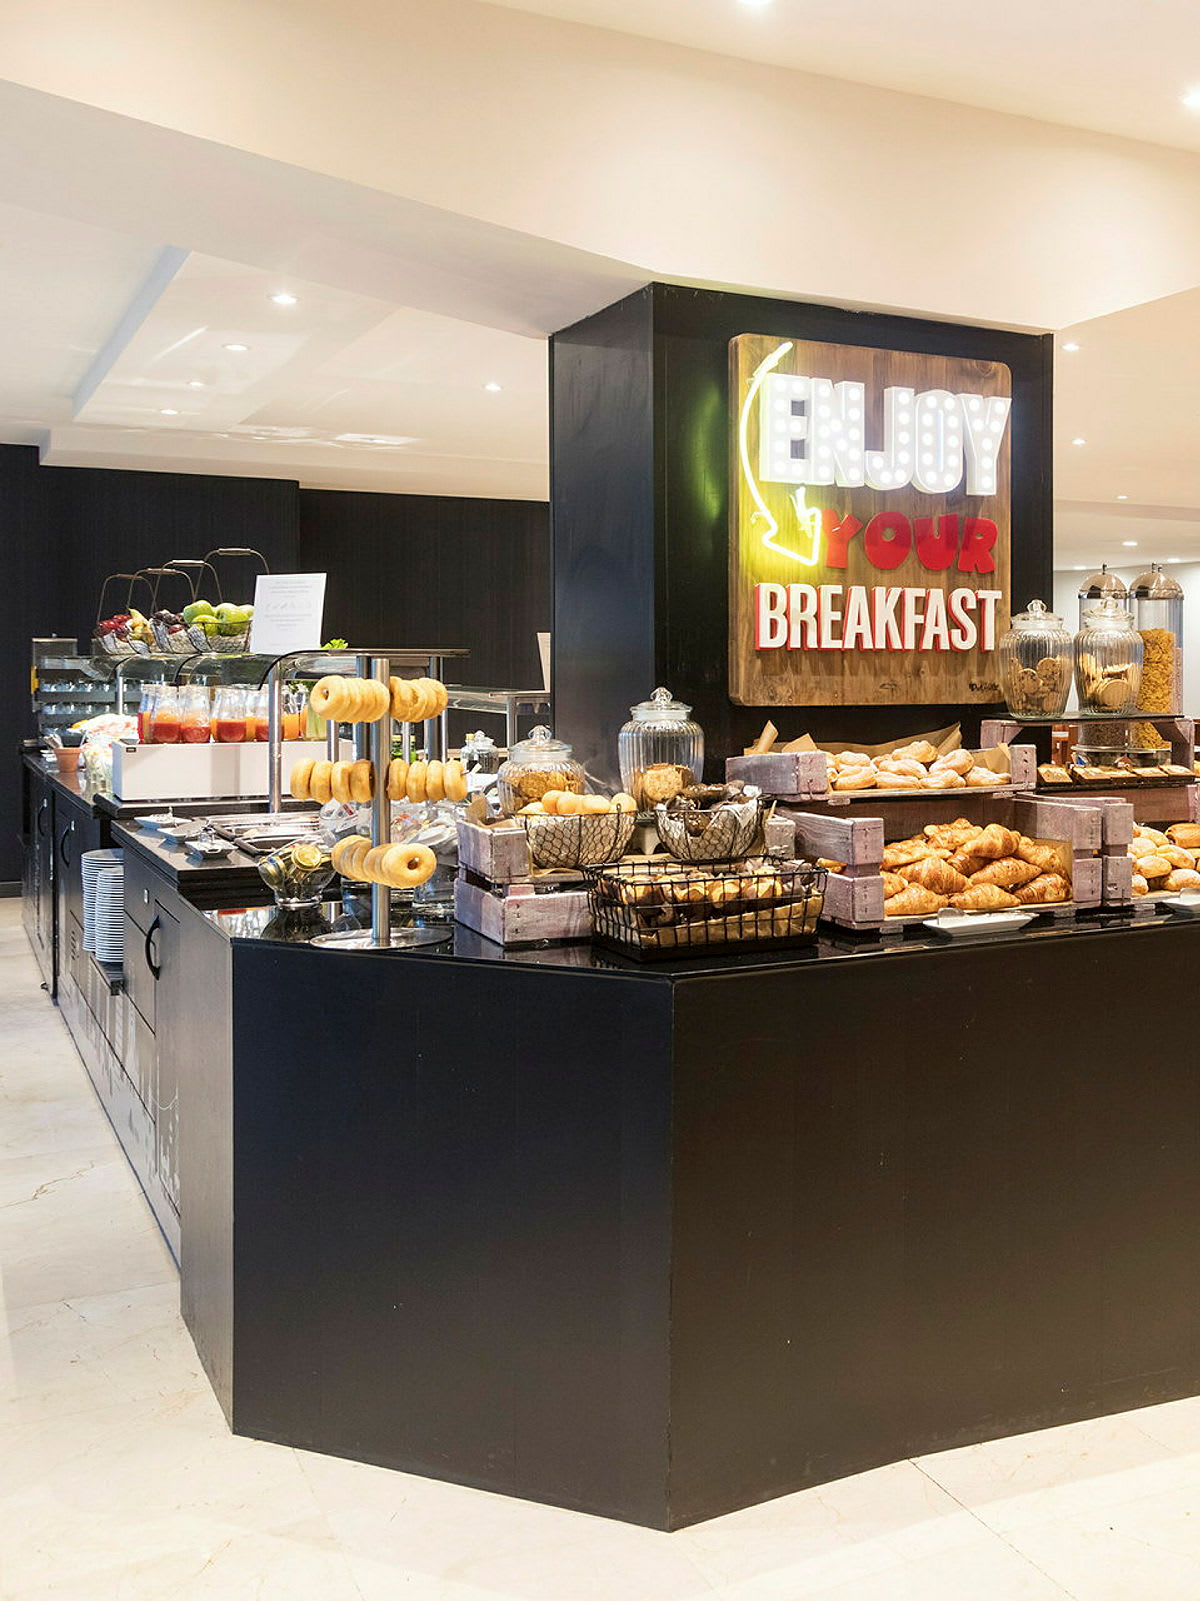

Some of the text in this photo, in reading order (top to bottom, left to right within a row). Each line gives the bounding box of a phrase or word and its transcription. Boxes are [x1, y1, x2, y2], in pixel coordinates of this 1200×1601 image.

[759, 373, 1012, 496] ENJOY
[820, 510, 998, 573] YOUR
[755, 582, 1002, 651] BREAKFAST
